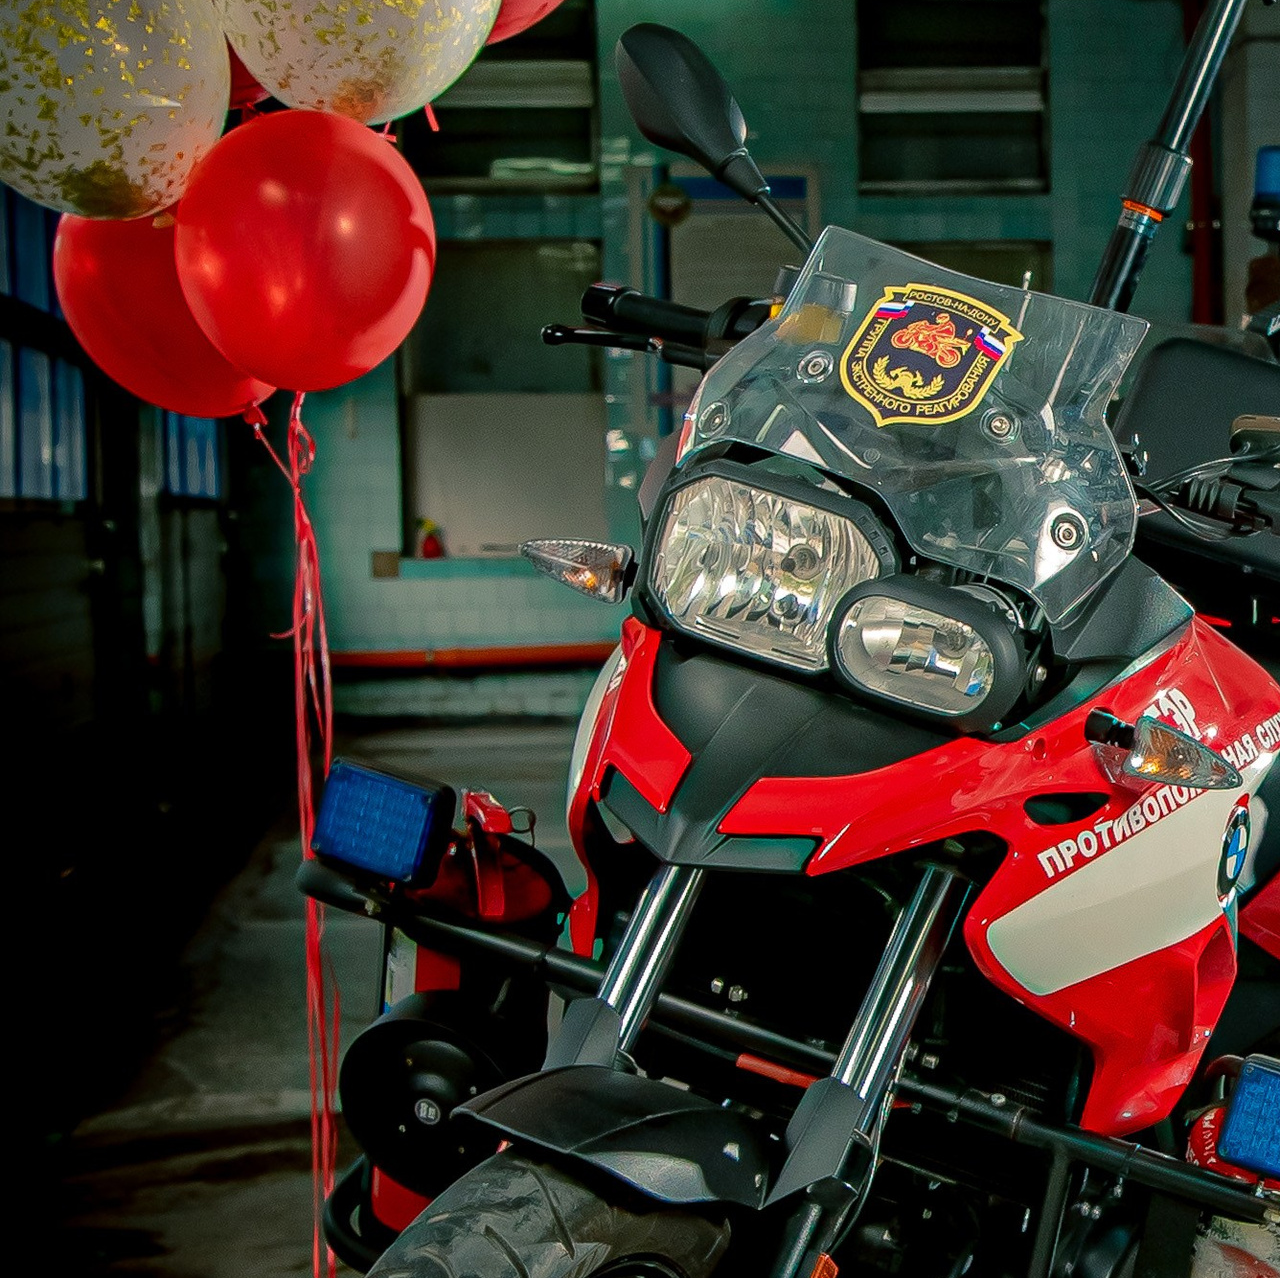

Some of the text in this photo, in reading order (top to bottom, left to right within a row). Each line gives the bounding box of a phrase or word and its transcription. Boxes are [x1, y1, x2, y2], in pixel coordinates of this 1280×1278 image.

[908, 290, 1000, 328] РОСТОВ-НА-ДОНУ
[854, 318, 889, 359] ГРУППА
[915, 355, 991, 416] РЕАГИРОВАНИЯ
